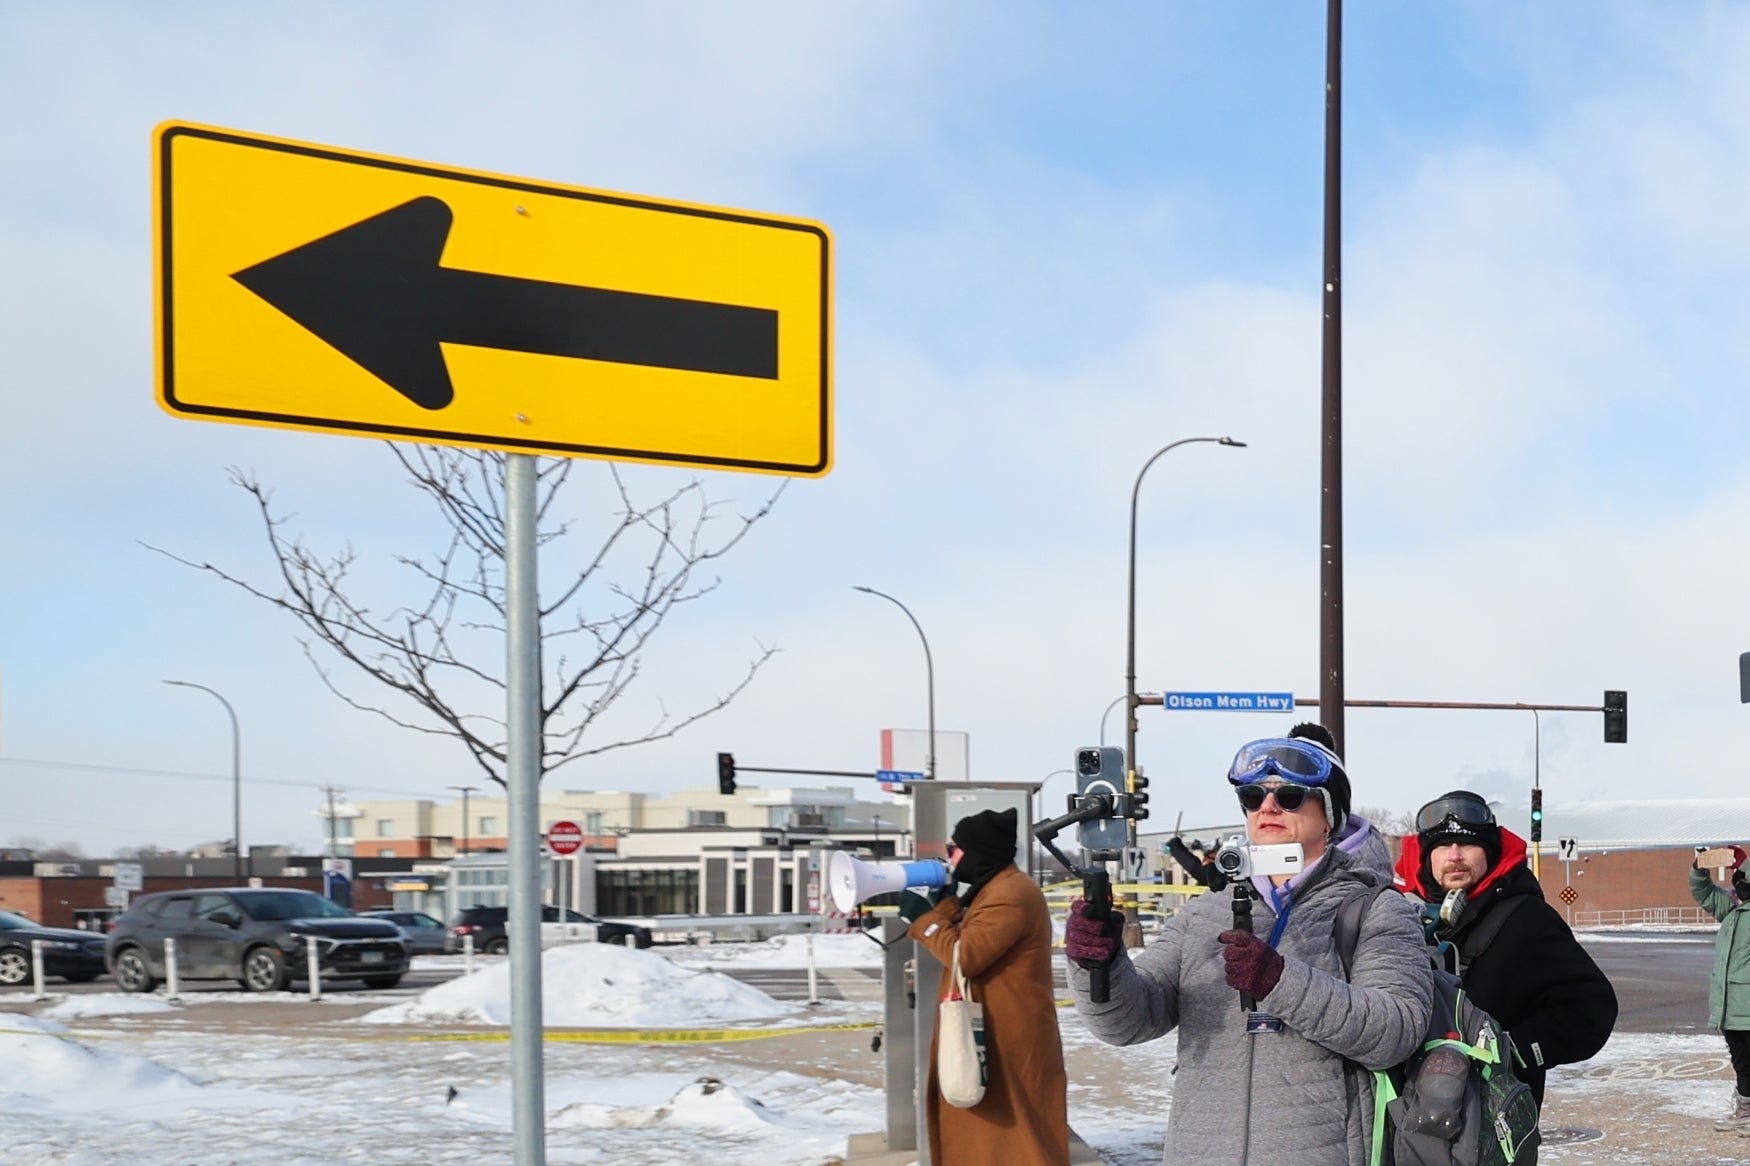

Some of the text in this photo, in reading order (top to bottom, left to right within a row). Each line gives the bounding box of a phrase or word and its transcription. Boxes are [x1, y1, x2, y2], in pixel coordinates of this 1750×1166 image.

[1168, 695, 1290, 710] Olson Mem Hwy
